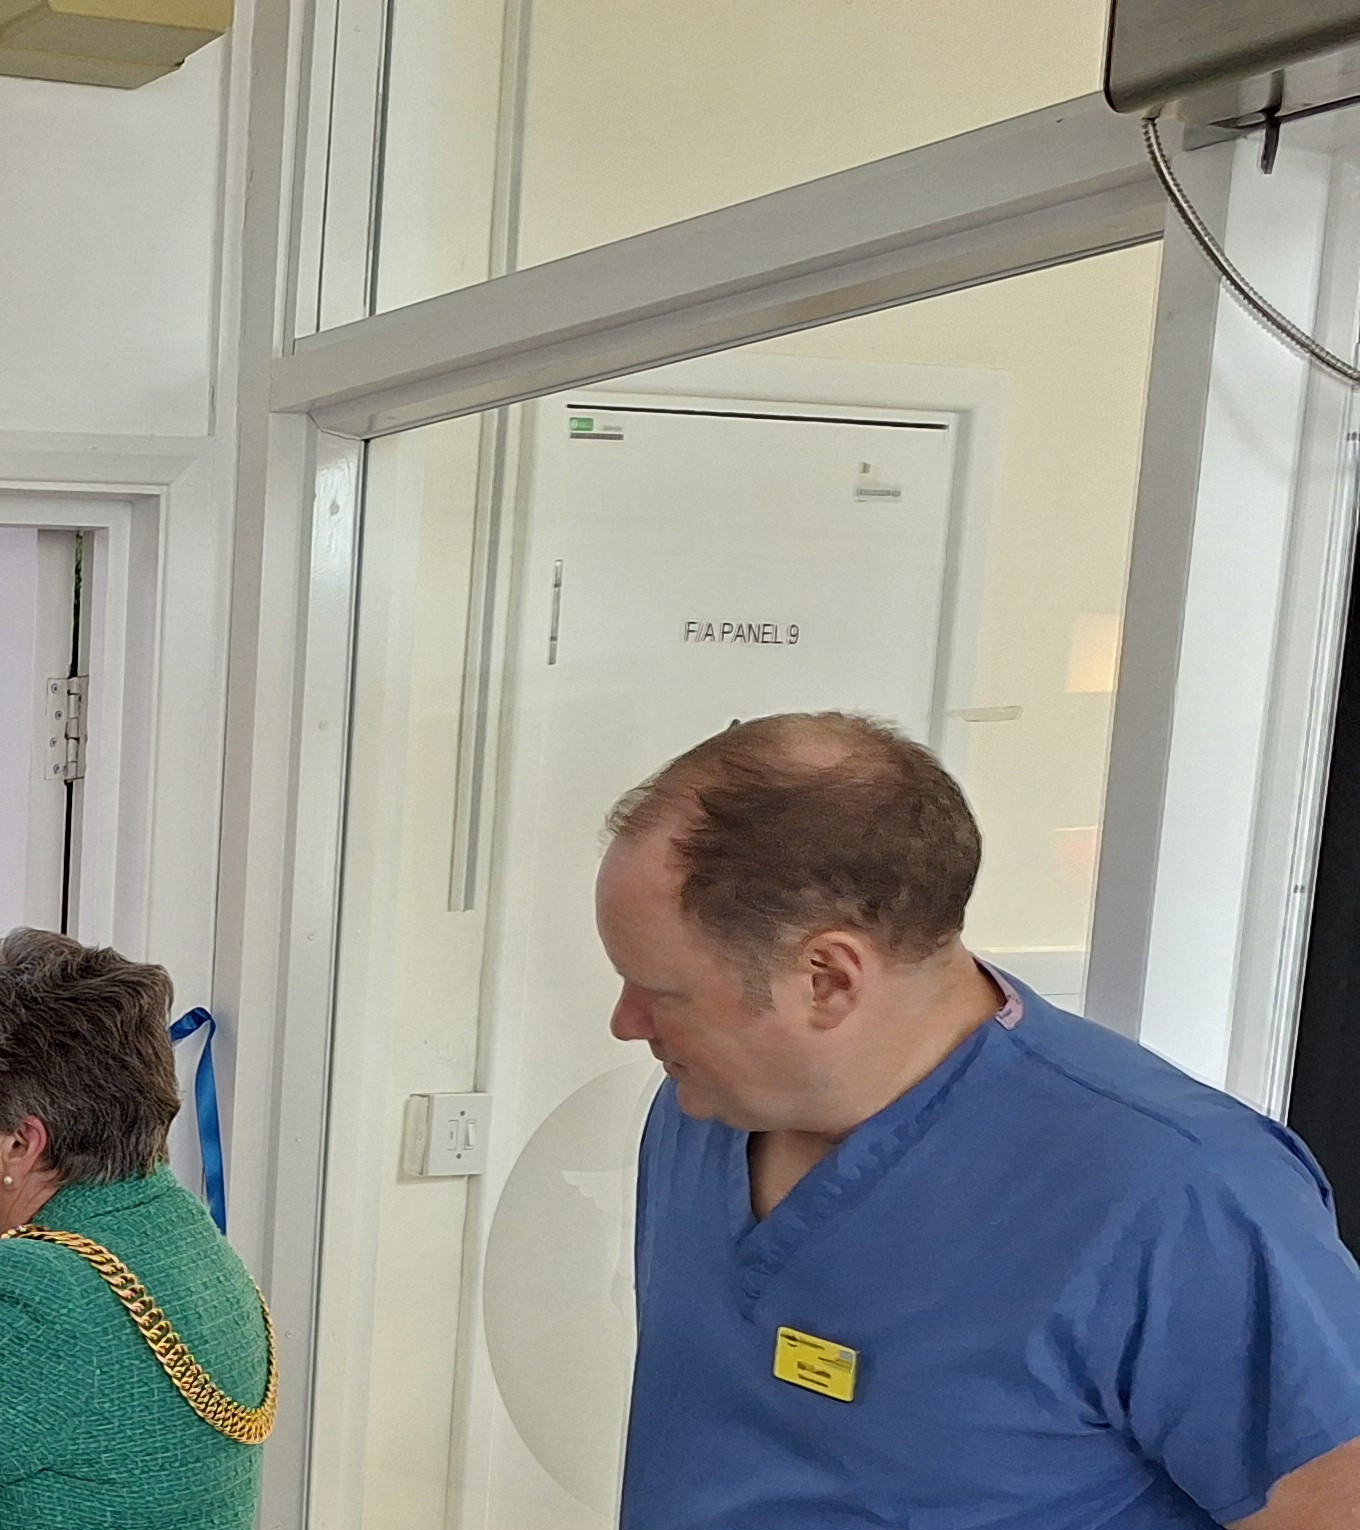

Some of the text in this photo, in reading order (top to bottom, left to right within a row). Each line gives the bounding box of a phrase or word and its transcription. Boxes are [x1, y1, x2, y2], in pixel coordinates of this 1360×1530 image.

[685, 621, 800, 645] F/A PANEL 9
